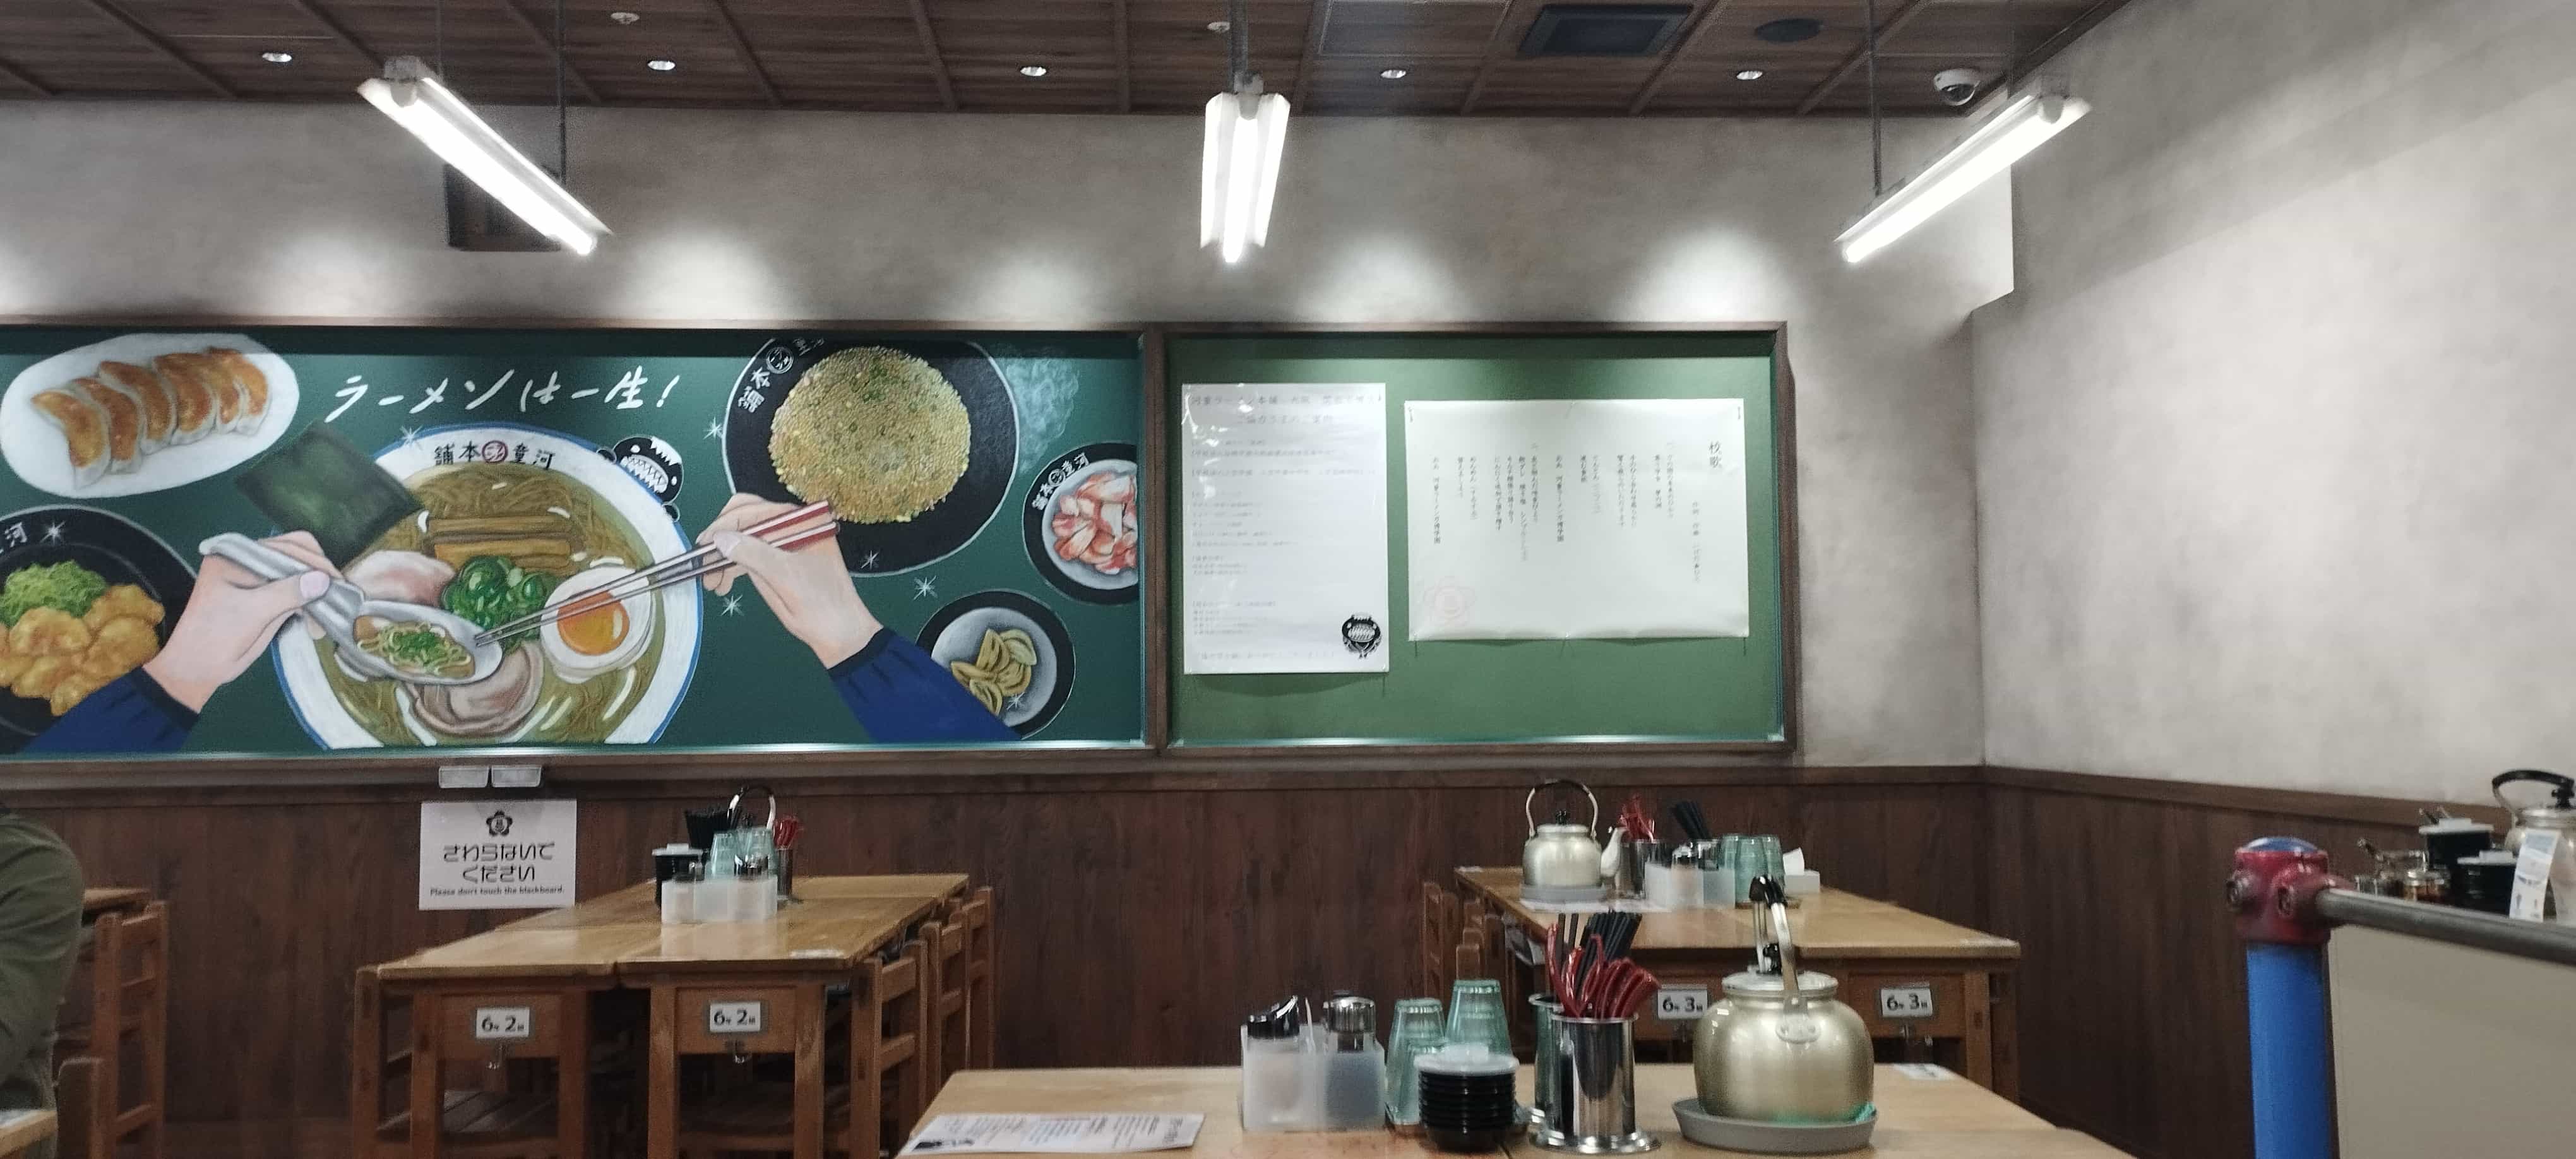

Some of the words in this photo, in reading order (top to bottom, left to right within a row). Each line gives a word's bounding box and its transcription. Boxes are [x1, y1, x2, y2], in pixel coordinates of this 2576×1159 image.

[0, 521, 28, 554] 河
[443, 842, 555, 862] さわらないで
[462, 864, 535, 883] ください
[431, 888, 455, 896] Please
[480, 886, 502, 895] touch
[504, 886, 516, 894] the
